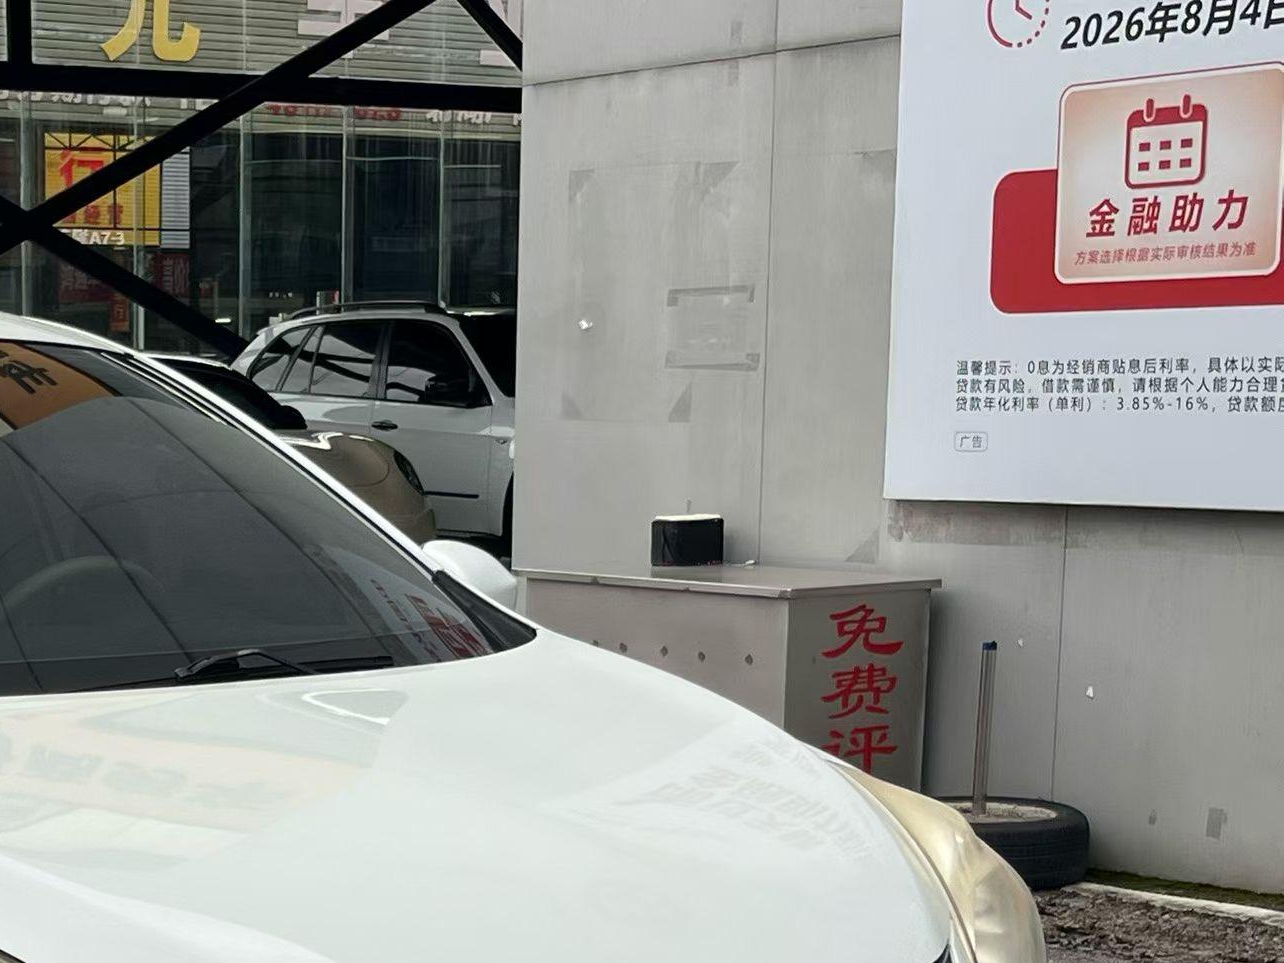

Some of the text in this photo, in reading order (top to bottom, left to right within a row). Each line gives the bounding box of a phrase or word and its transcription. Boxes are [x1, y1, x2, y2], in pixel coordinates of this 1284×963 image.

[1086, 189, 1249, 238] 金融助力
[1074, 241, 1257, 266] 方案选择根据实际审核结果为准
[959, 434, 983, 449] 广告
[821, 604, 904, 775] 免费评
